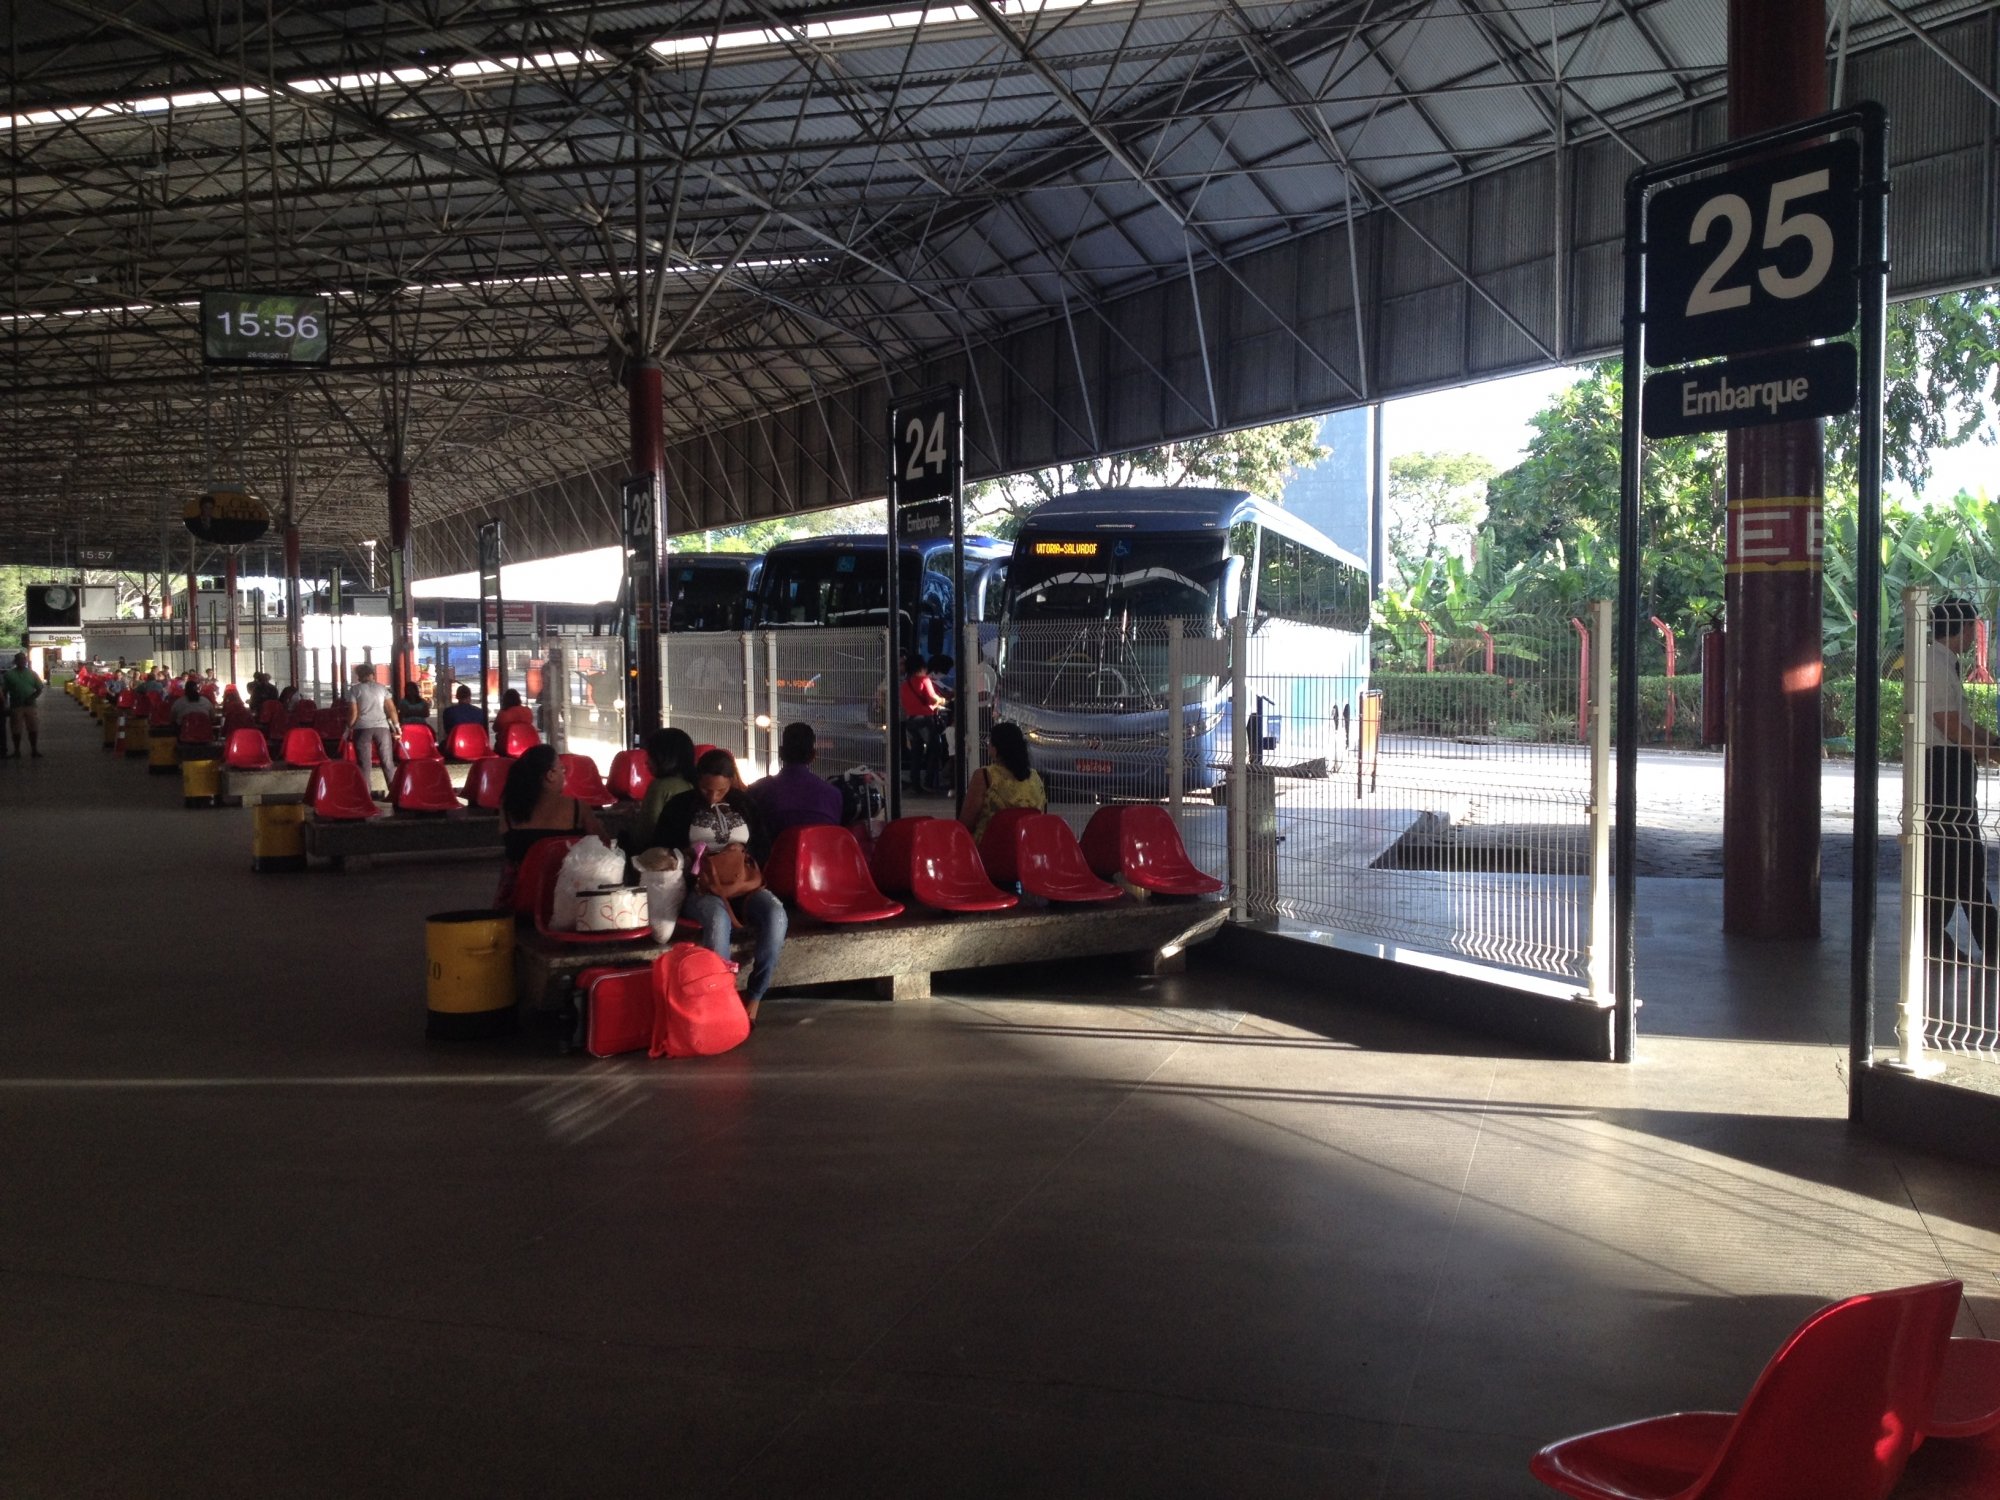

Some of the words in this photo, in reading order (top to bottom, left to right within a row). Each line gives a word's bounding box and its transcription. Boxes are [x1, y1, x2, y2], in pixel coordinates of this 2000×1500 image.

[1684, 168, 1835, 318] 25
[217, 311, 319, 339] 15:56
[1681, 376, 1809, 418] Embarque
[905, 411, 947, 481] 24
[632, 491, 651, 537] 23
[906, 511, 941, 534] Embarque
[80, 551, 113, 559] 15:57
